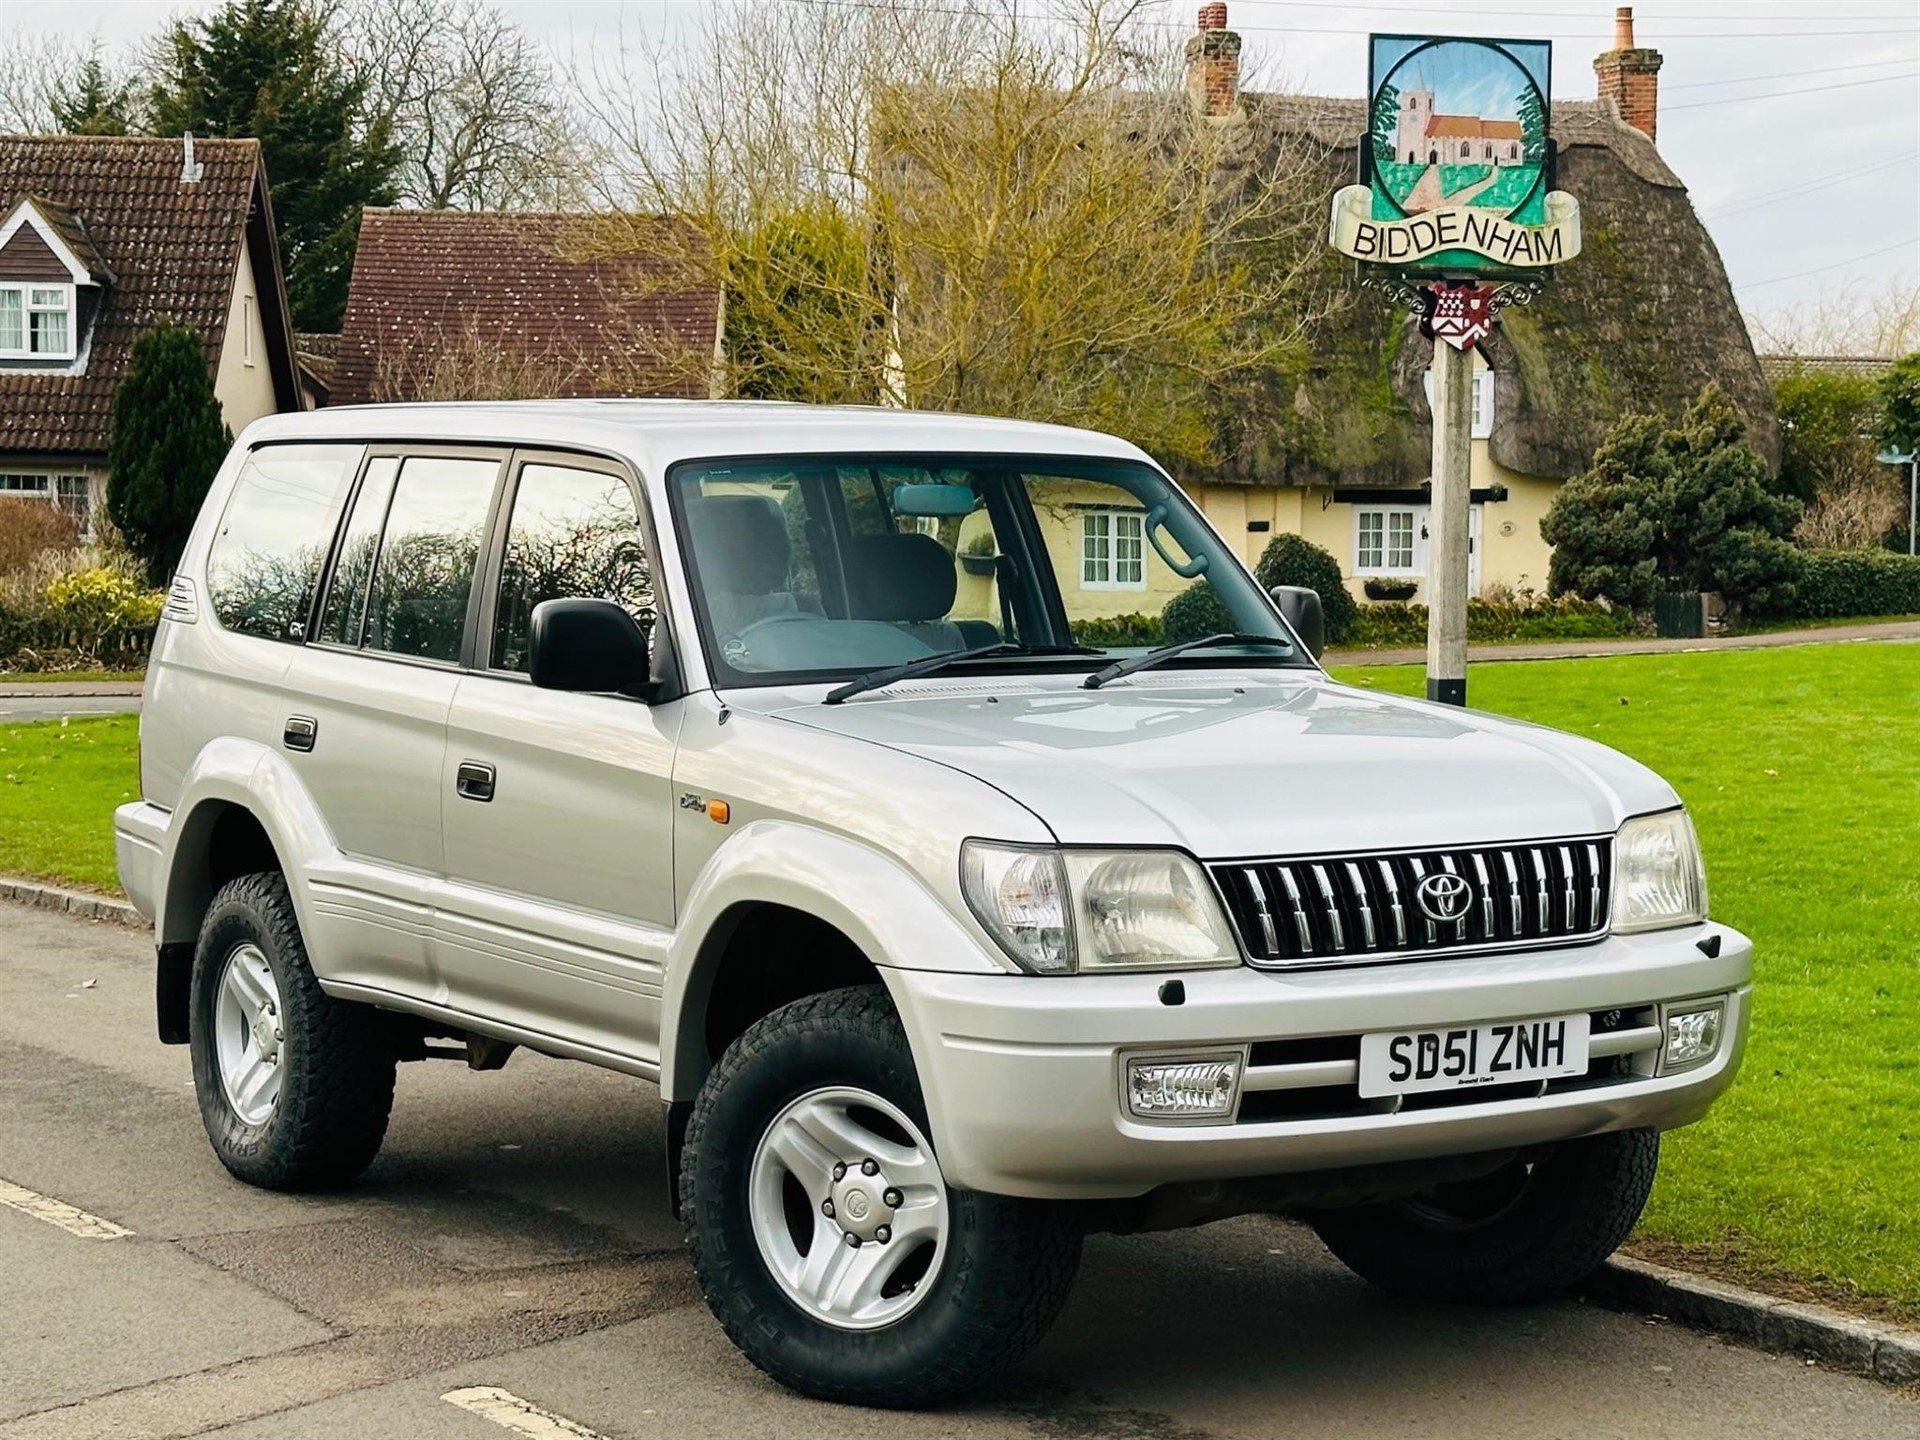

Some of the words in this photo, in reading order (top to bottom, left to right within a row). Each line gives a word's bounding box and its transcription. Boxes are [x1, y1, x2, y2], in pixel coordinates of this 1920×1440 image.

[1353, 212, 1563, 262] BIDDENHAM
[1388, 1029, 1478, 1082] SD51
[1489, 1021, 1566, 1073] ZNH
